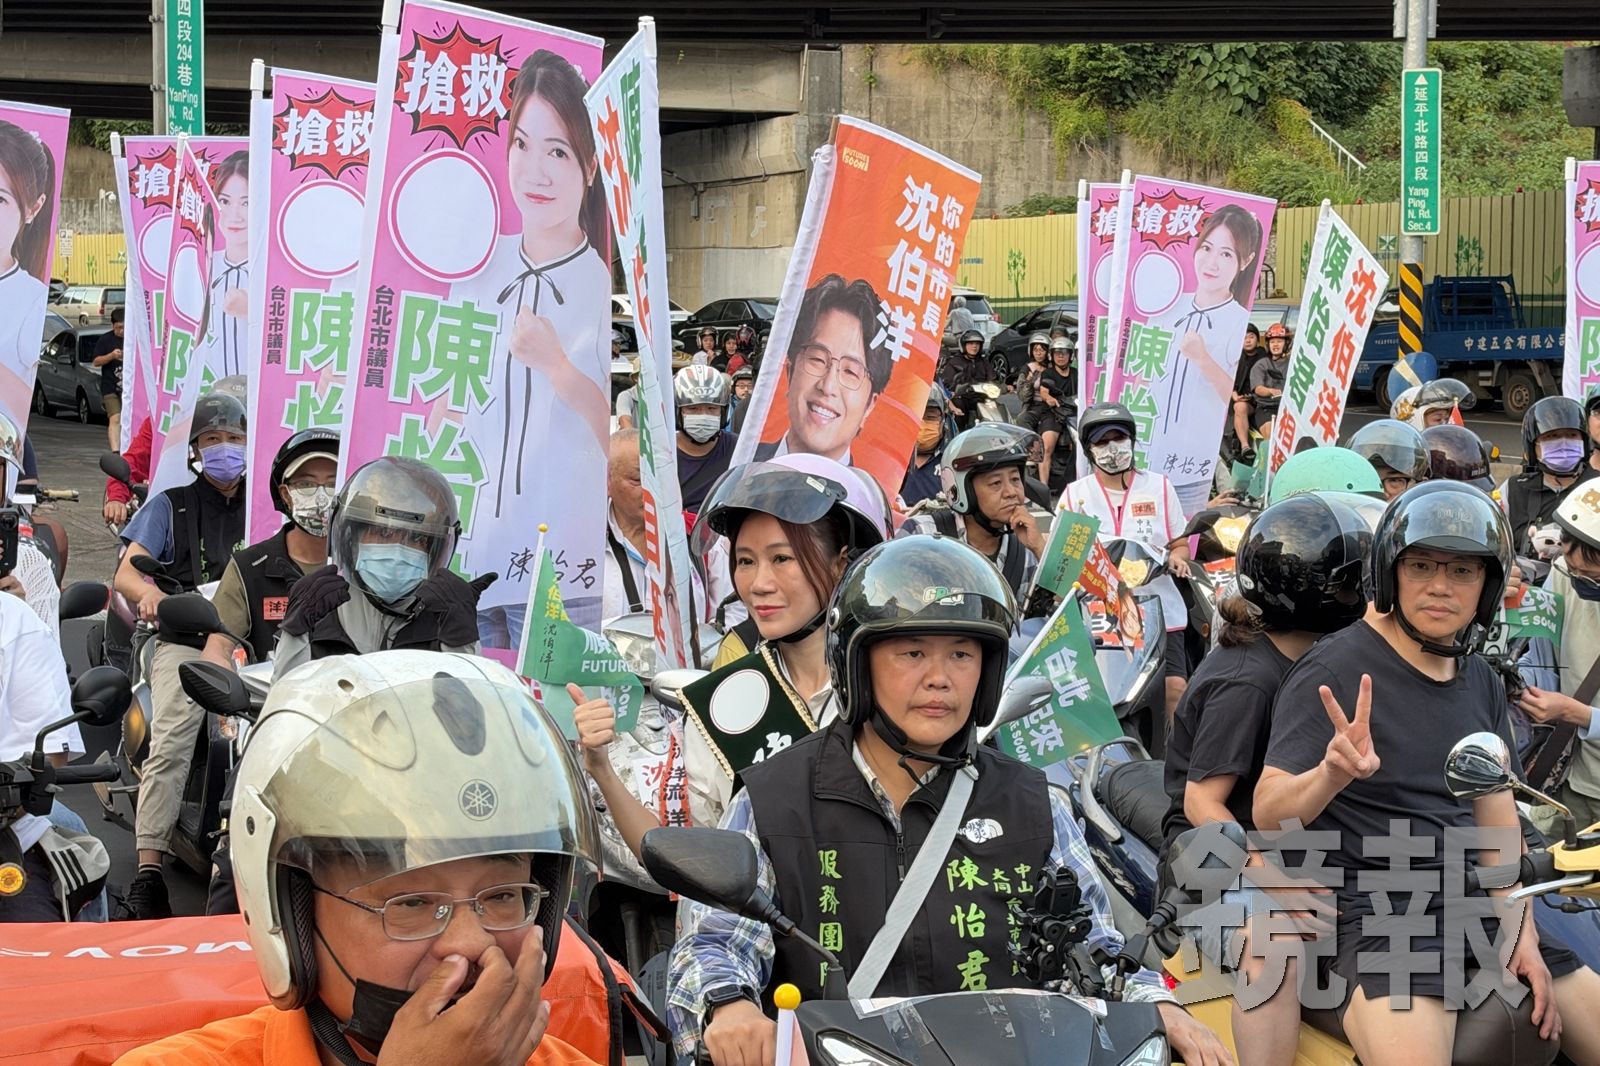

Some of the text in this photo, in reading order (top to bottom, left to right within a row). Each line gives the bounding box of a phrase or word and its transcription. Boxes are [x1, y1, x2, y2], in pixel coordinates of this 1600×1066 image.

[169, 88, 198, 108] YanPing
[401, 50, 511, 119] 搶救
[169, 105, 195, 121] N. Rd.
[282, 109, 374, 156] 搶救
[1414, 87, 1428, 181] 延平北路四段
[1136, 203, 1203, 236] 搶救
[1408, 186, 1429, 199] Yang
[1408, 198, 1426, 210] Ping
[1408, 209, 1432, 219] N. Rd.
[870, 175, 939, 362] 沈伯洋
[922, 195, 964, 337] 你的市長
[266, 285, 286, 365] 台北市議員
[363, 285, 394, 389] 台北市議員
[1289, 223, 1352, 414] 陳怡君
[1464, 334, 1566, 351] 中建五金有限公司
[1310, 257, 1377, 443] 沈伯洋
[384, 294, 498, 582] 陳怡
[1044, 646, 1091, 708] 台北
[1011, 729, 1031, 764] SOON
[992, 868, 1012, 894] 大同
[1014, 863, 1034, 893] 中山
[947, 856, 990, 991] 陳怡君
